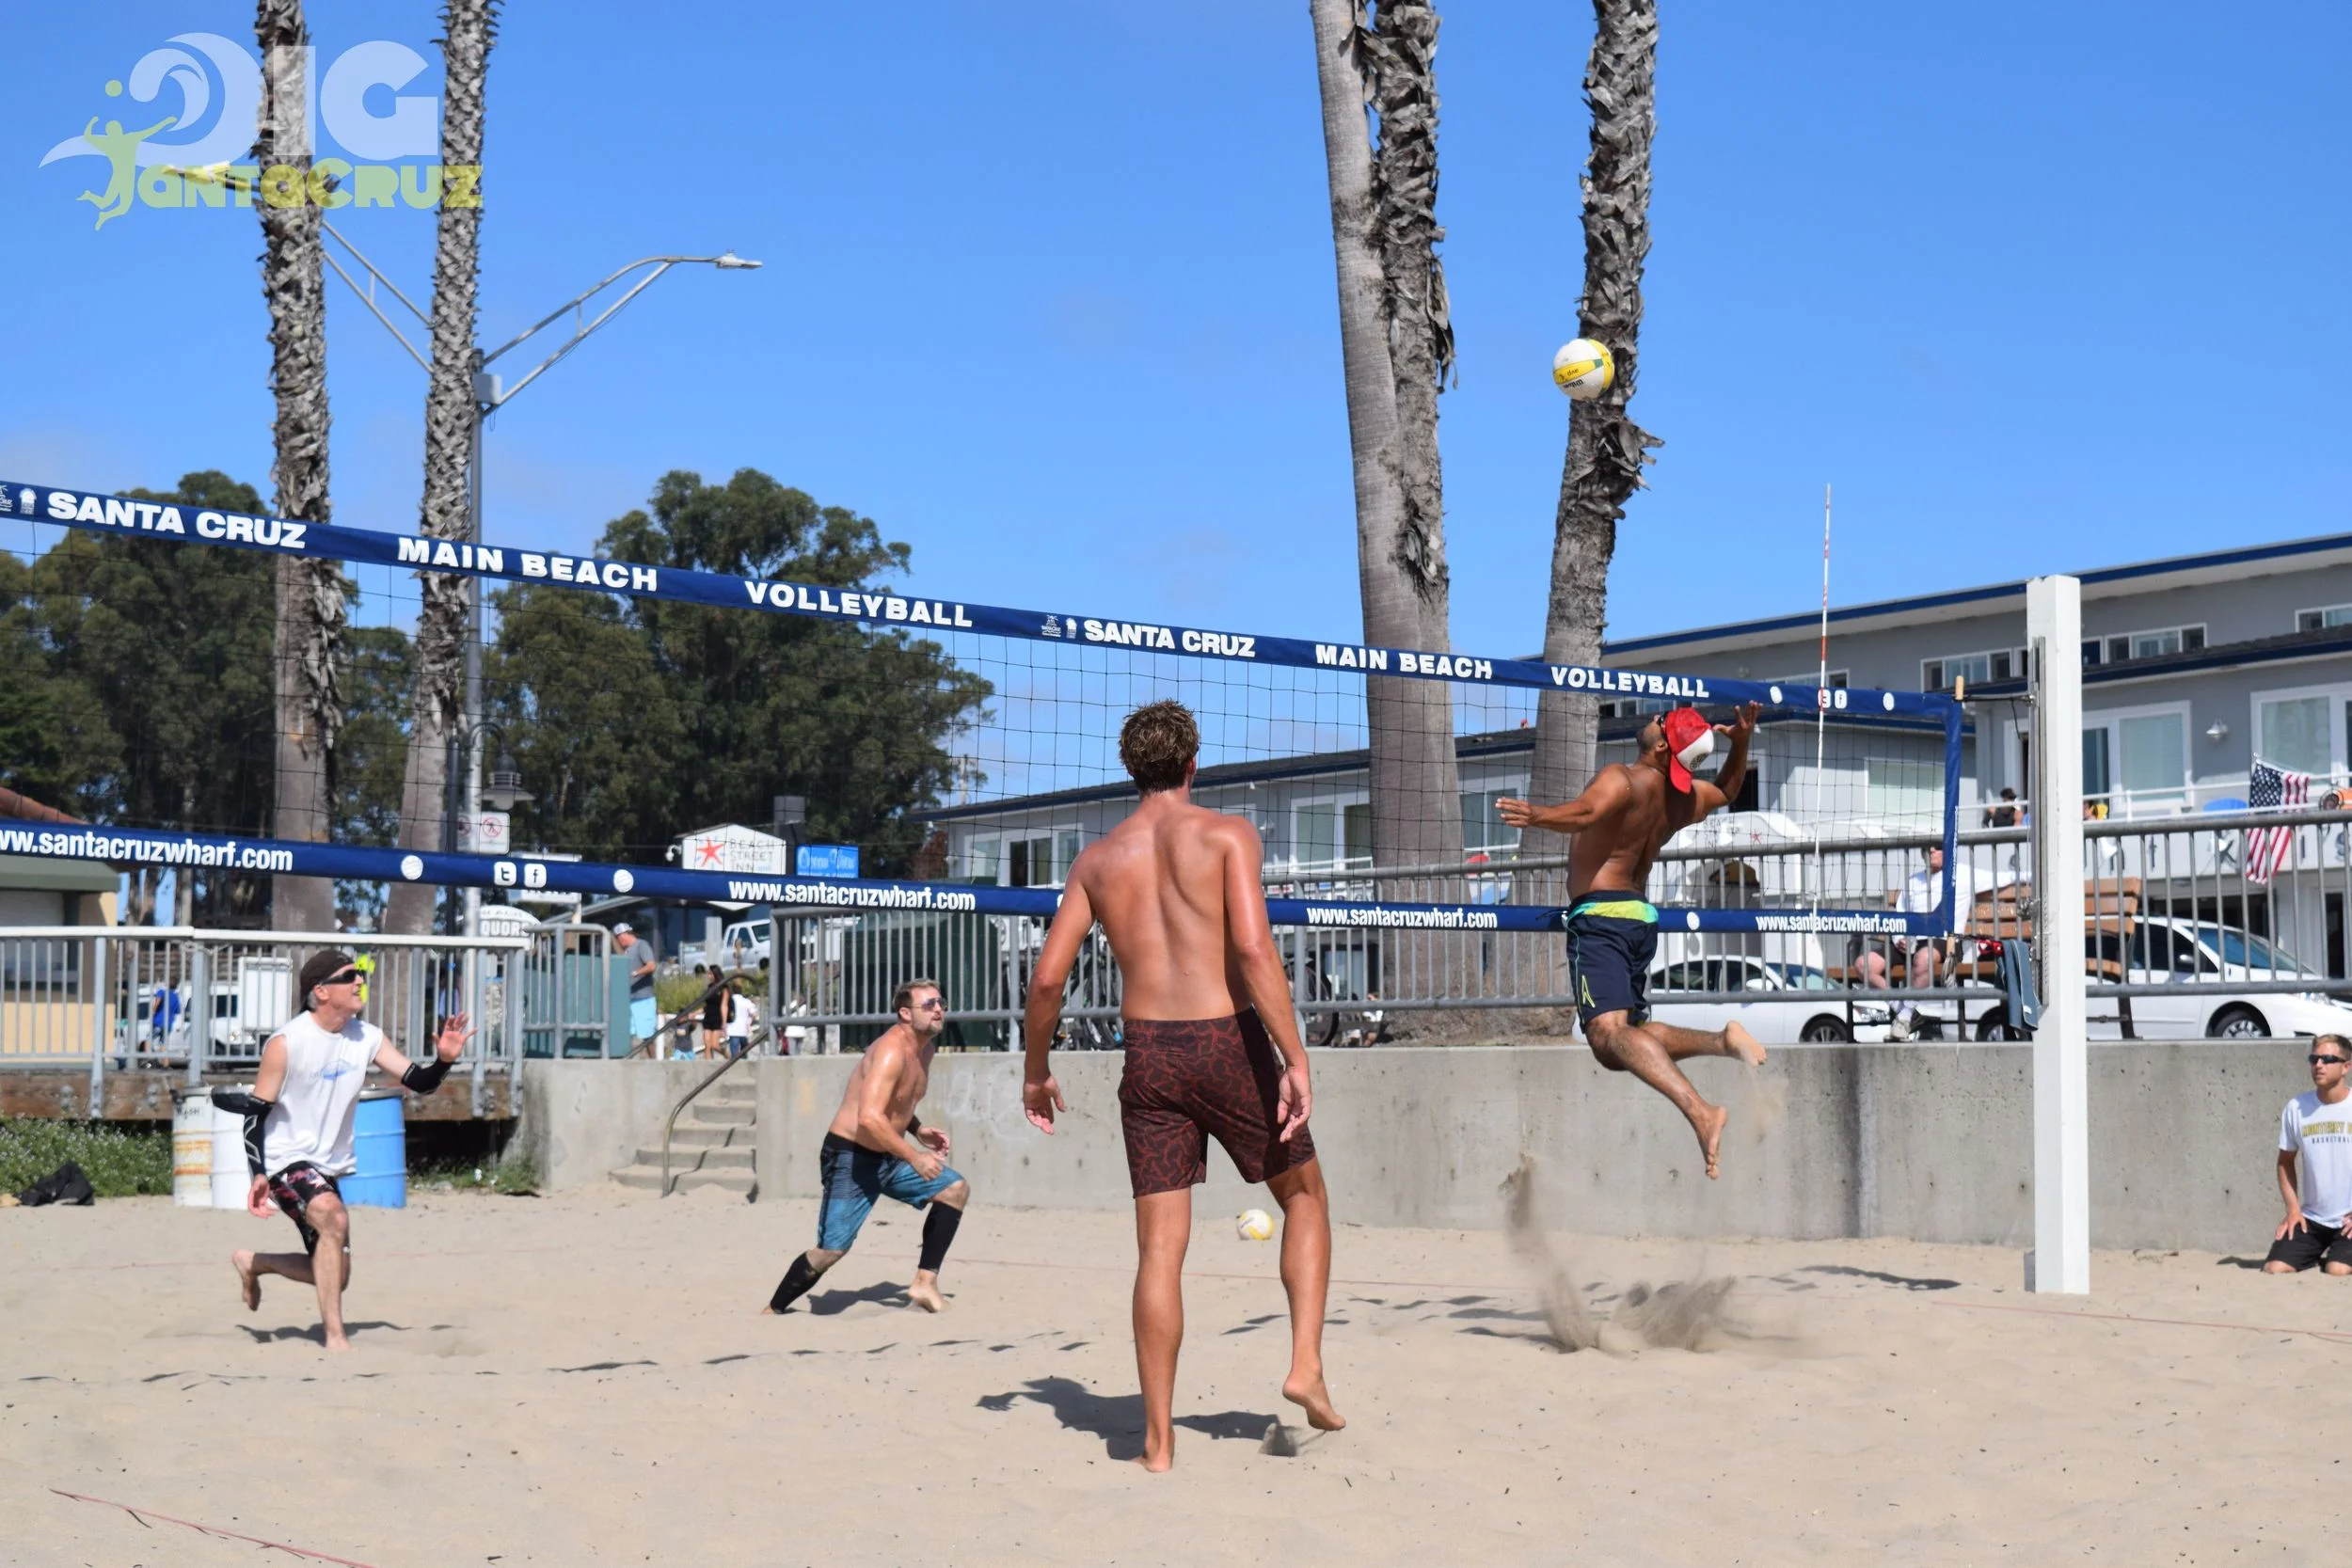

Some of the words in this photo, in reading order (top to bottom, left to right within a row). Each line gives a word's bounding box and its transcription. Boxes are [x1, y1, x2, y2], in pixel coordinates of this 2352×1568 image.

[48, 491, 185, 534] SANTA
[196, 511, 307, 549] CRUZ
[398, 537, 503, 573] MAIN
[520, 553, 658, 592] BEACH
[744, 580, 973, 627] VOLLEYBALL
[1084, 619, 1175, 649] SANTA
[1182, 629, 1256, 657] CRUZ
[1315, 644, 1388, 671] MAIN
[1398, 653, 1493, 680] BEACH
[1550, 666, 1710, 699] VOLLEYBALL
[730, 849, 773, 863] STREET
[729, 881, 976, 911] www.santacruzwharf.com
[1307, 907, 1498, 928] www.santacruzwharf.com
